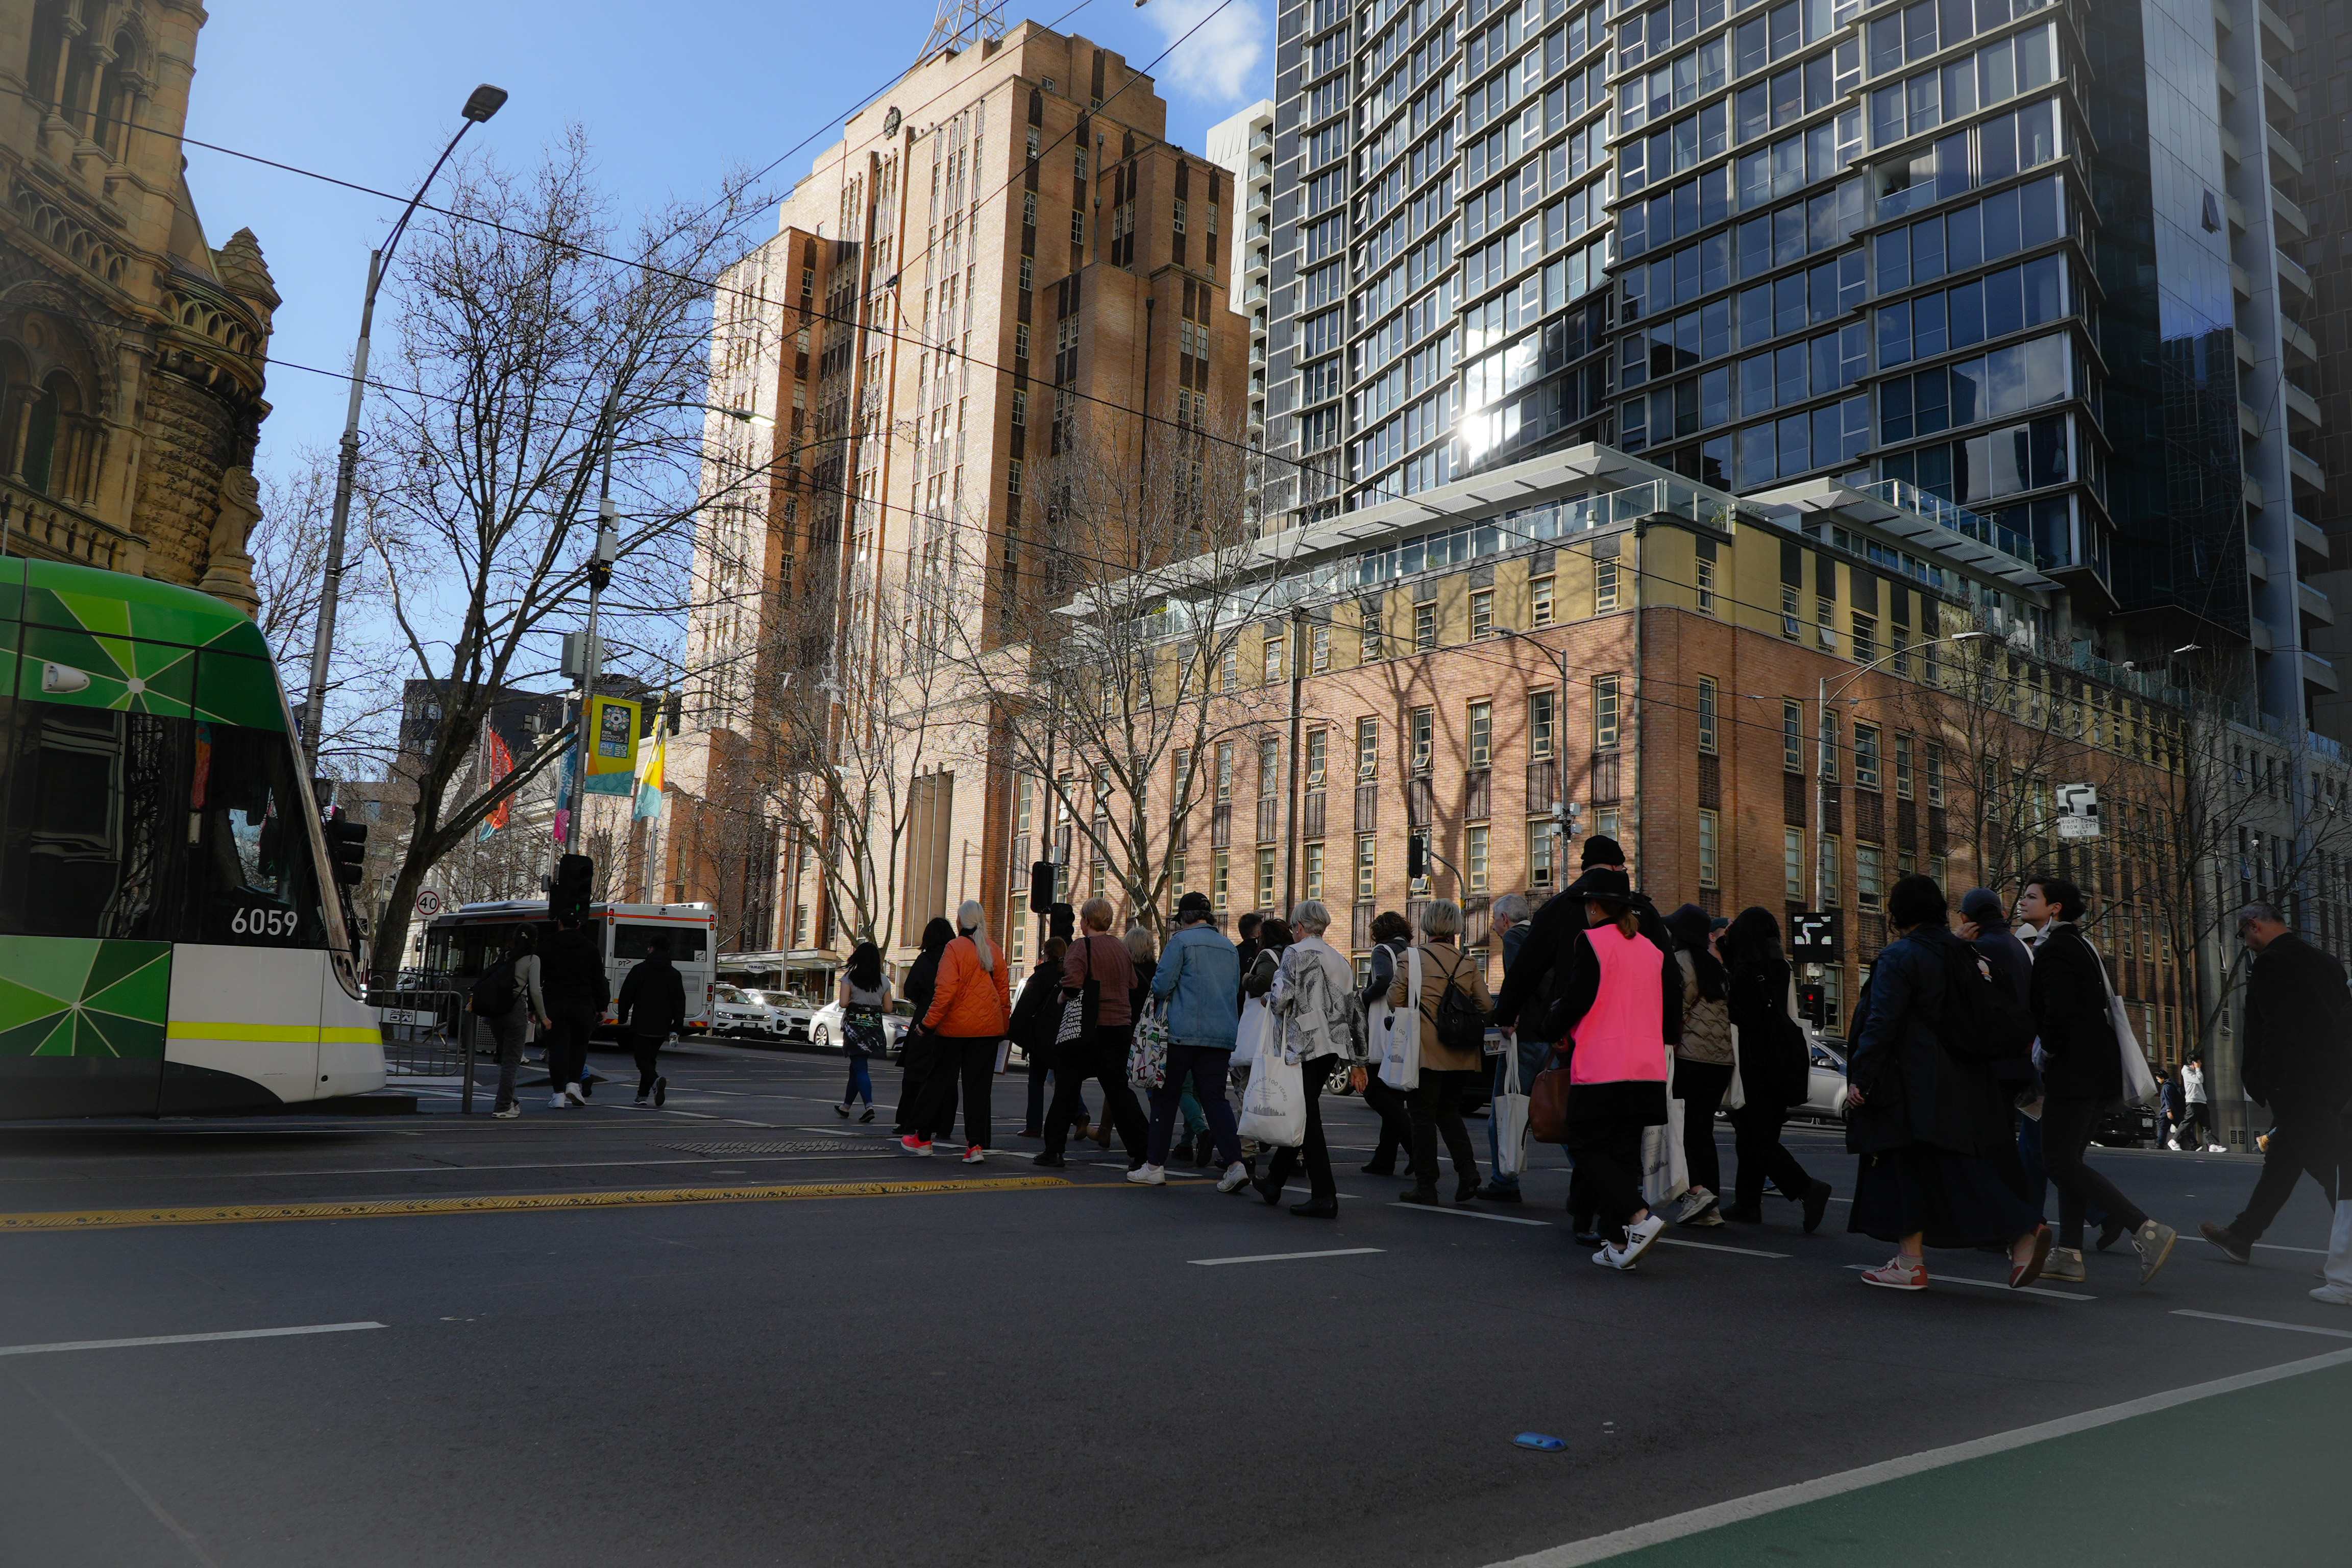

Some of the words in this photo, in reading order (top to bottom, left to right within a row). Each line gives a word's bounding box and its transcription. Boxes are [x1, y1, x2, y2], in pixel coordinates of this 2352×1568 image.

[419, 897, 437, 910] 40
[231, 908, 298, 936] 6059
[390, 1014, 413, 1022] MC
[1269, 1078, 1278, 1086] 100
[1279, 1085, 1288, 1101] YEARS
